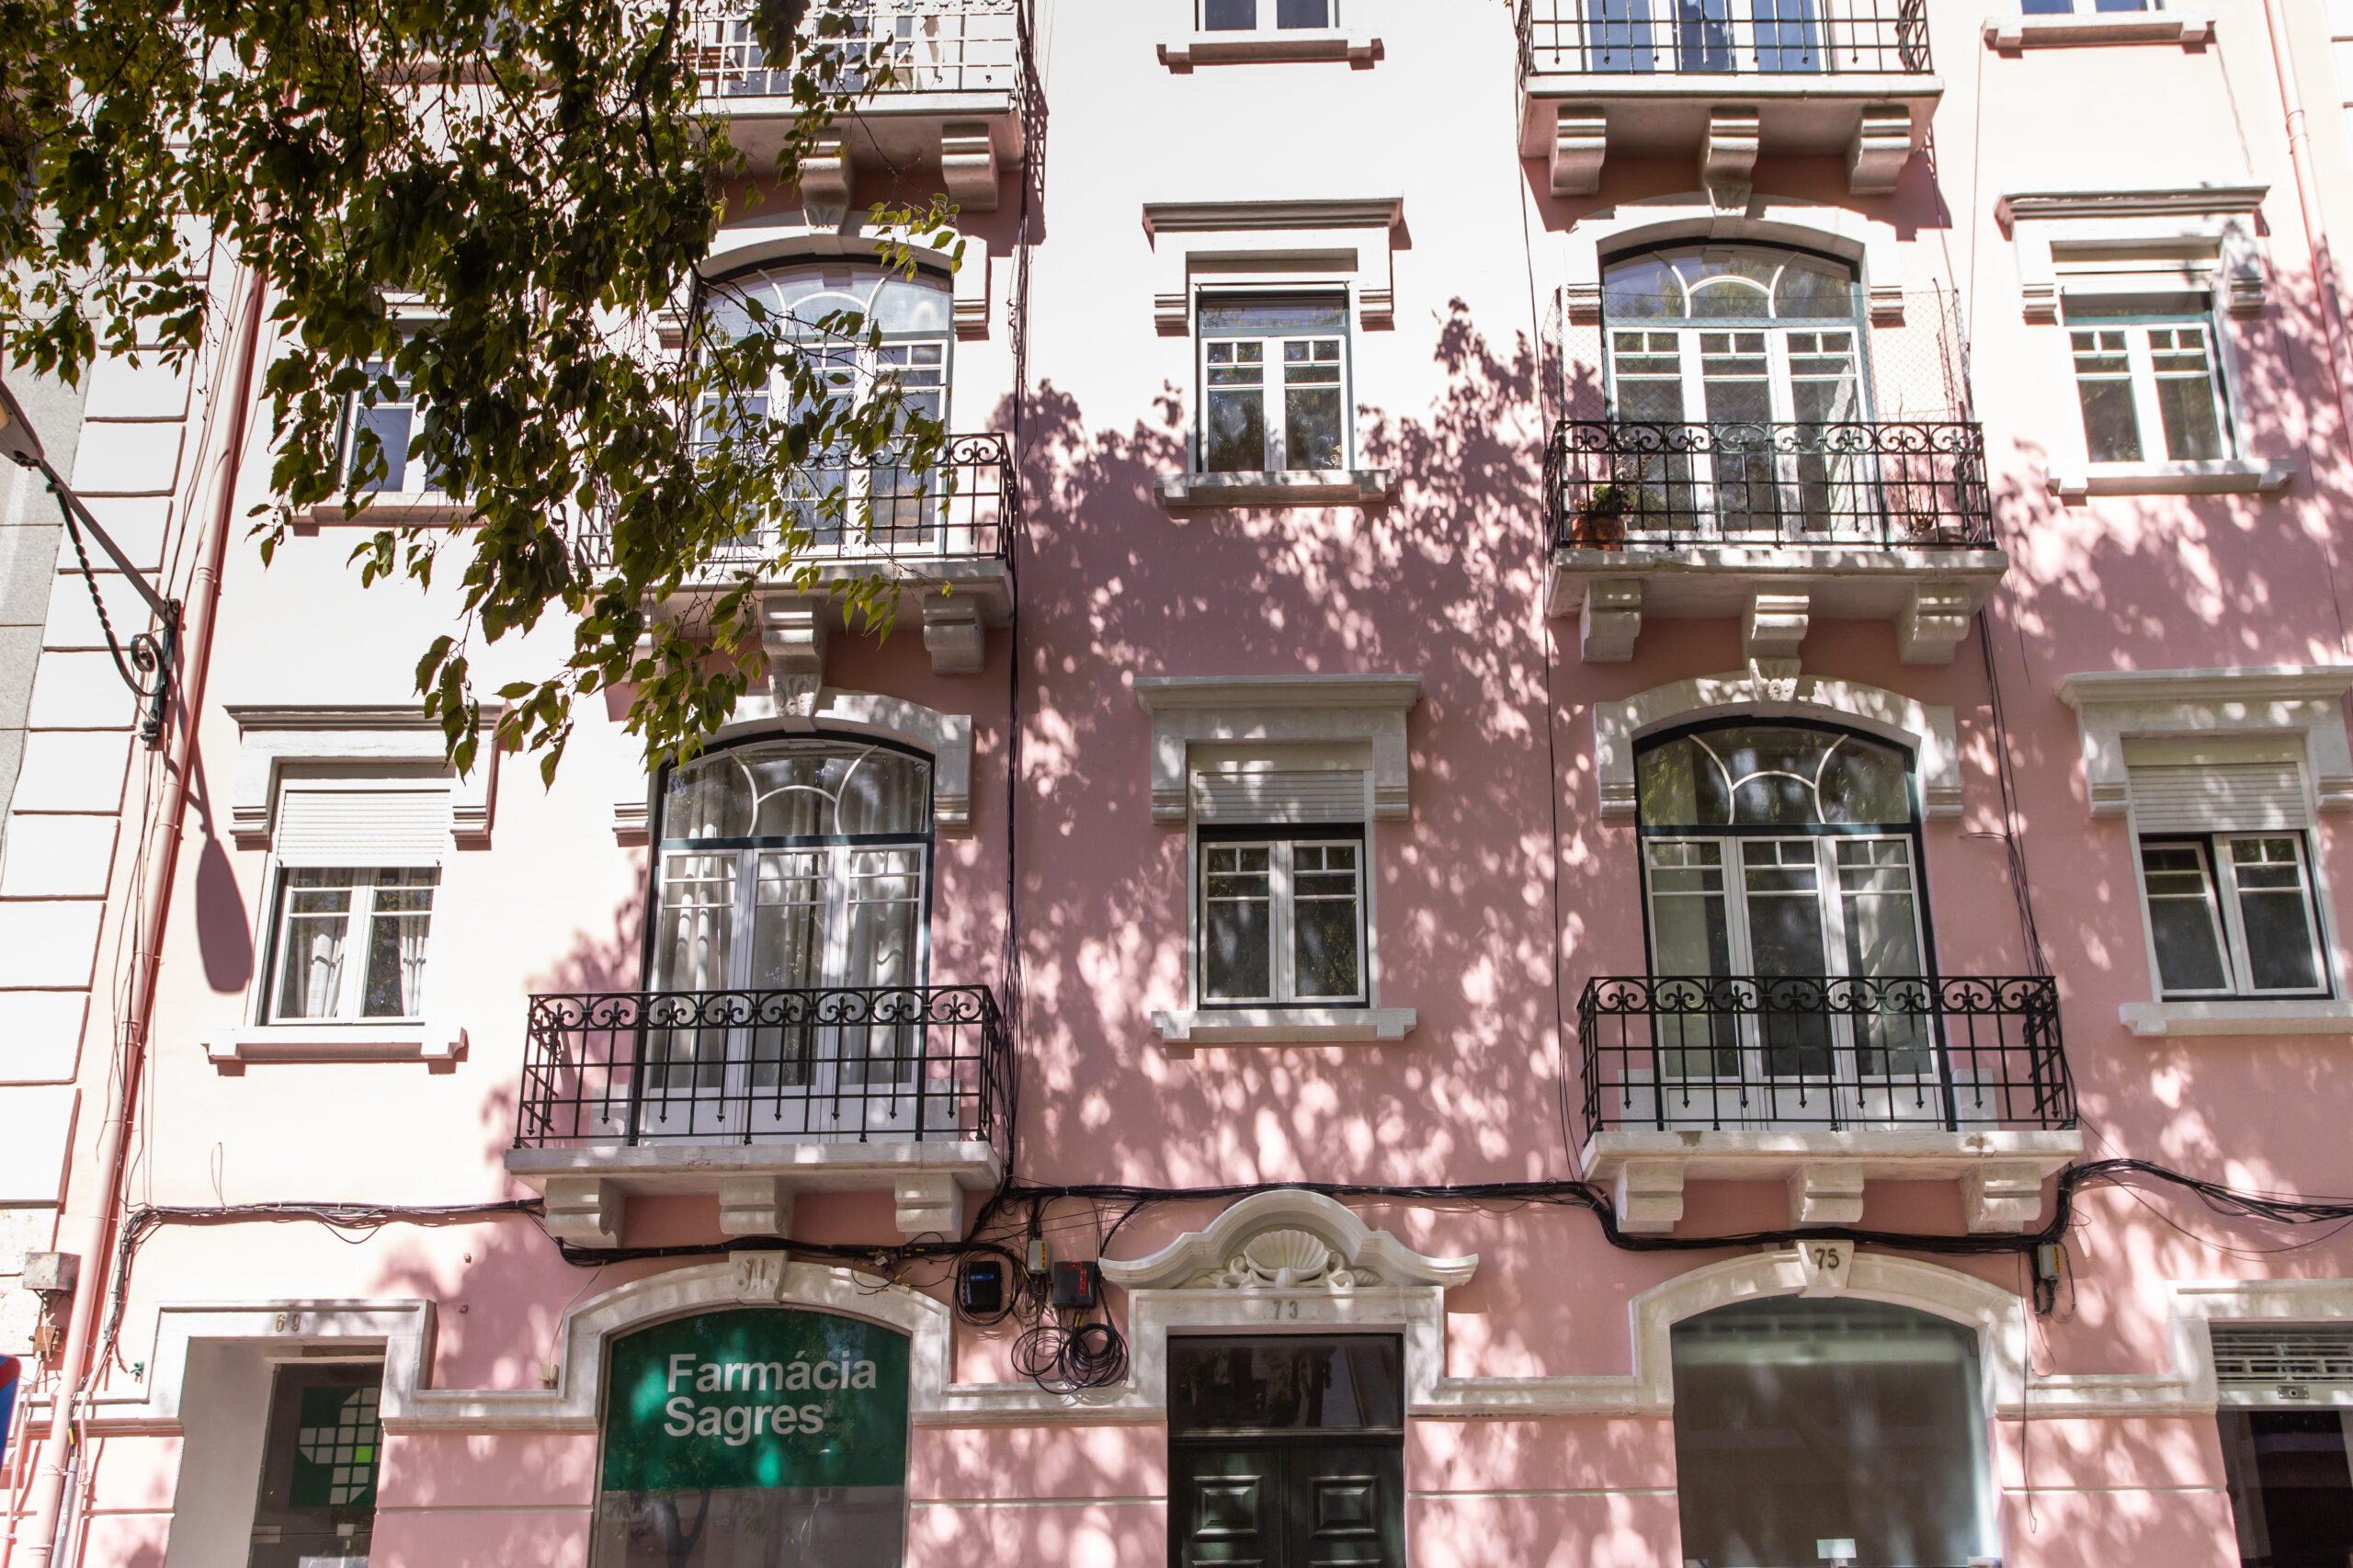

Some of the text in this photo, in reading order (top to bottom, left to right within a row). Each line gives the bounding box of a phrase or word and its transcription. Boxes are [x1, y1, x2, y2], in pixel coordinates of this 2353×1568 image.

[1814, 1247, 1839, 1270] 75
[1273, 1299, 1298, 1320] 73
[276, 1314, 301, 1333] 69
[667, 1350, 877, 1392] Farmácia
[664, 1396, 824, 1446] Sagres
